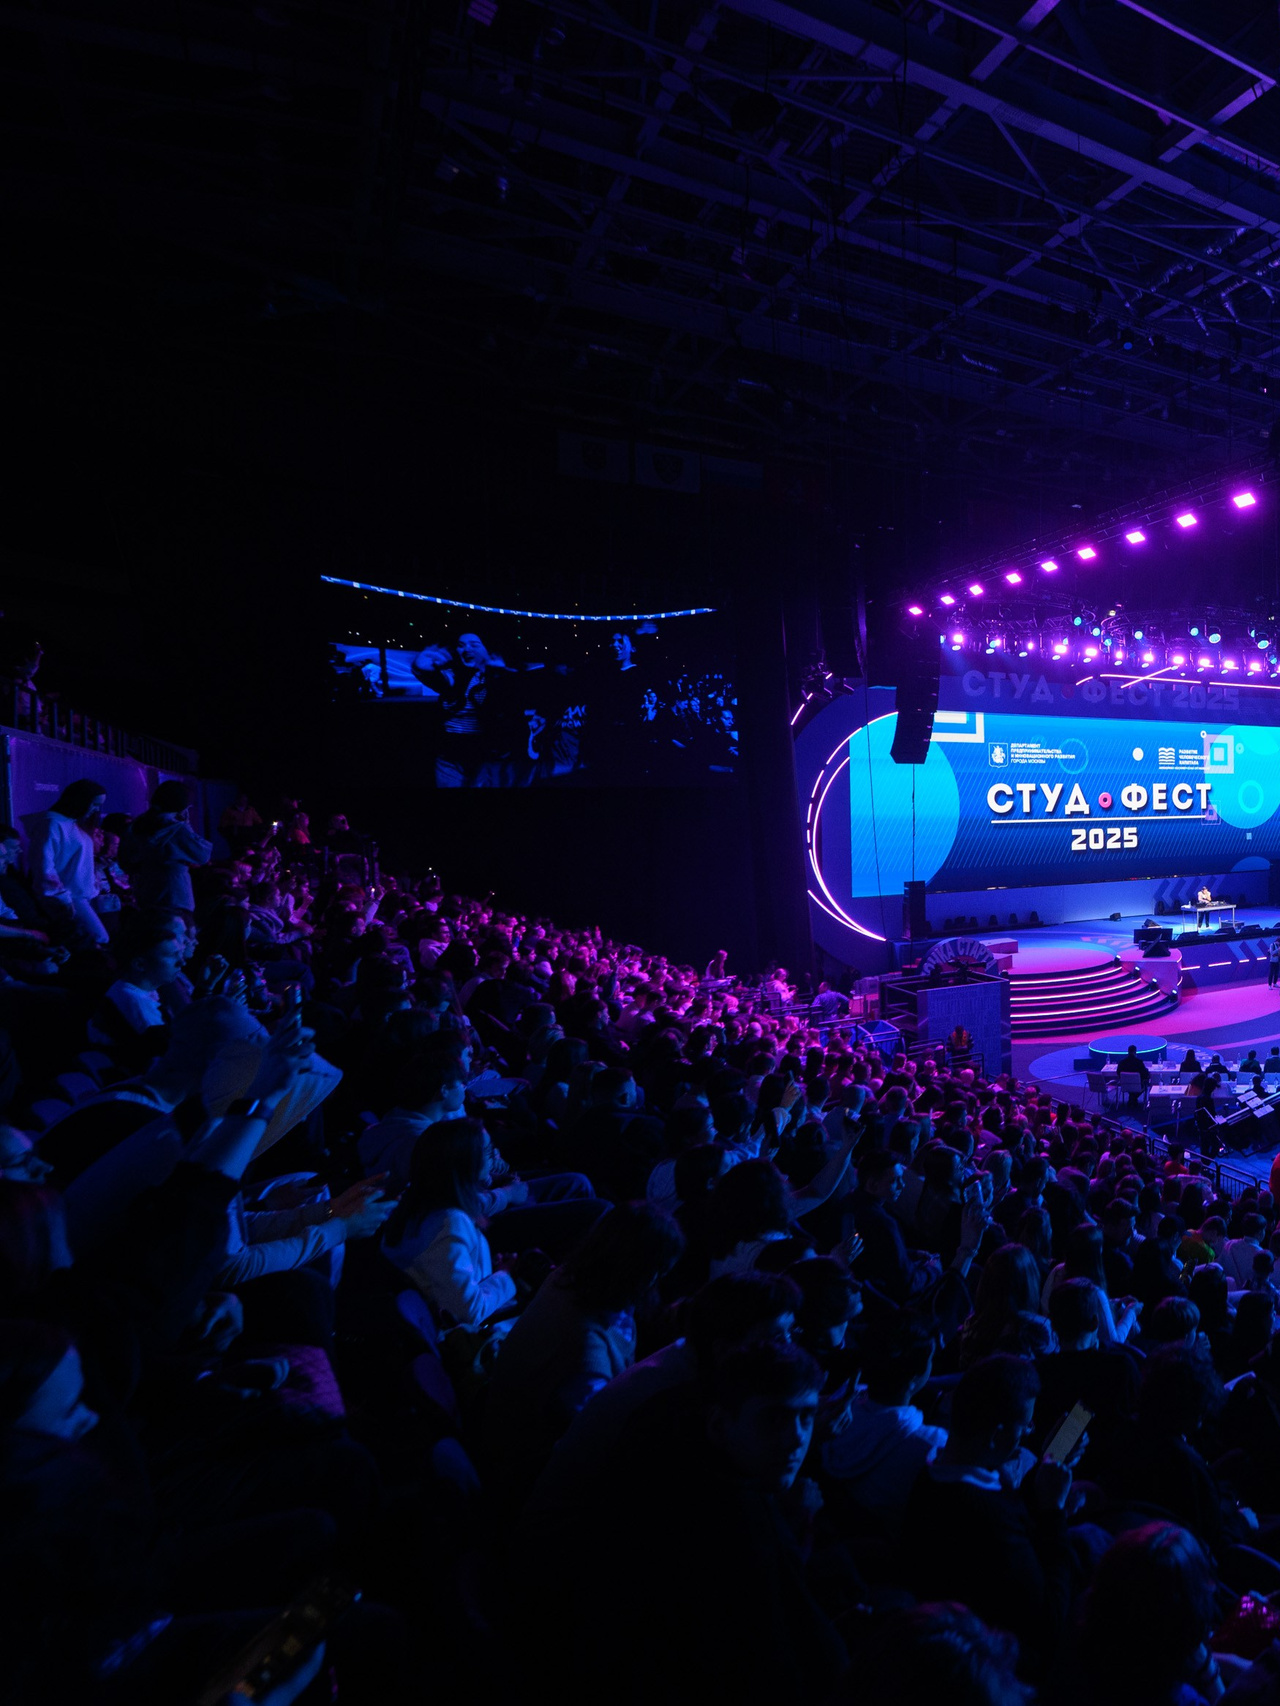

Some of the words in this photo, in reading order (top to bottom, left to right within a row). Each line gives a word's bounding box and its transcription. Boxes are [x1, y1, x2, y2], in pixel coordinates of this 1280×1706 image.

[961, 669, 1054, 704] СТУД
[1080, 677, 1167, 708] ФЕСТ
[1172, 684, 1240, 711] 2025
[986, 782, 1090, 815] СТУД
[1121, 782, 1212, 811] ФЕСТ
[1071, 826, 1139, 851] 2025
